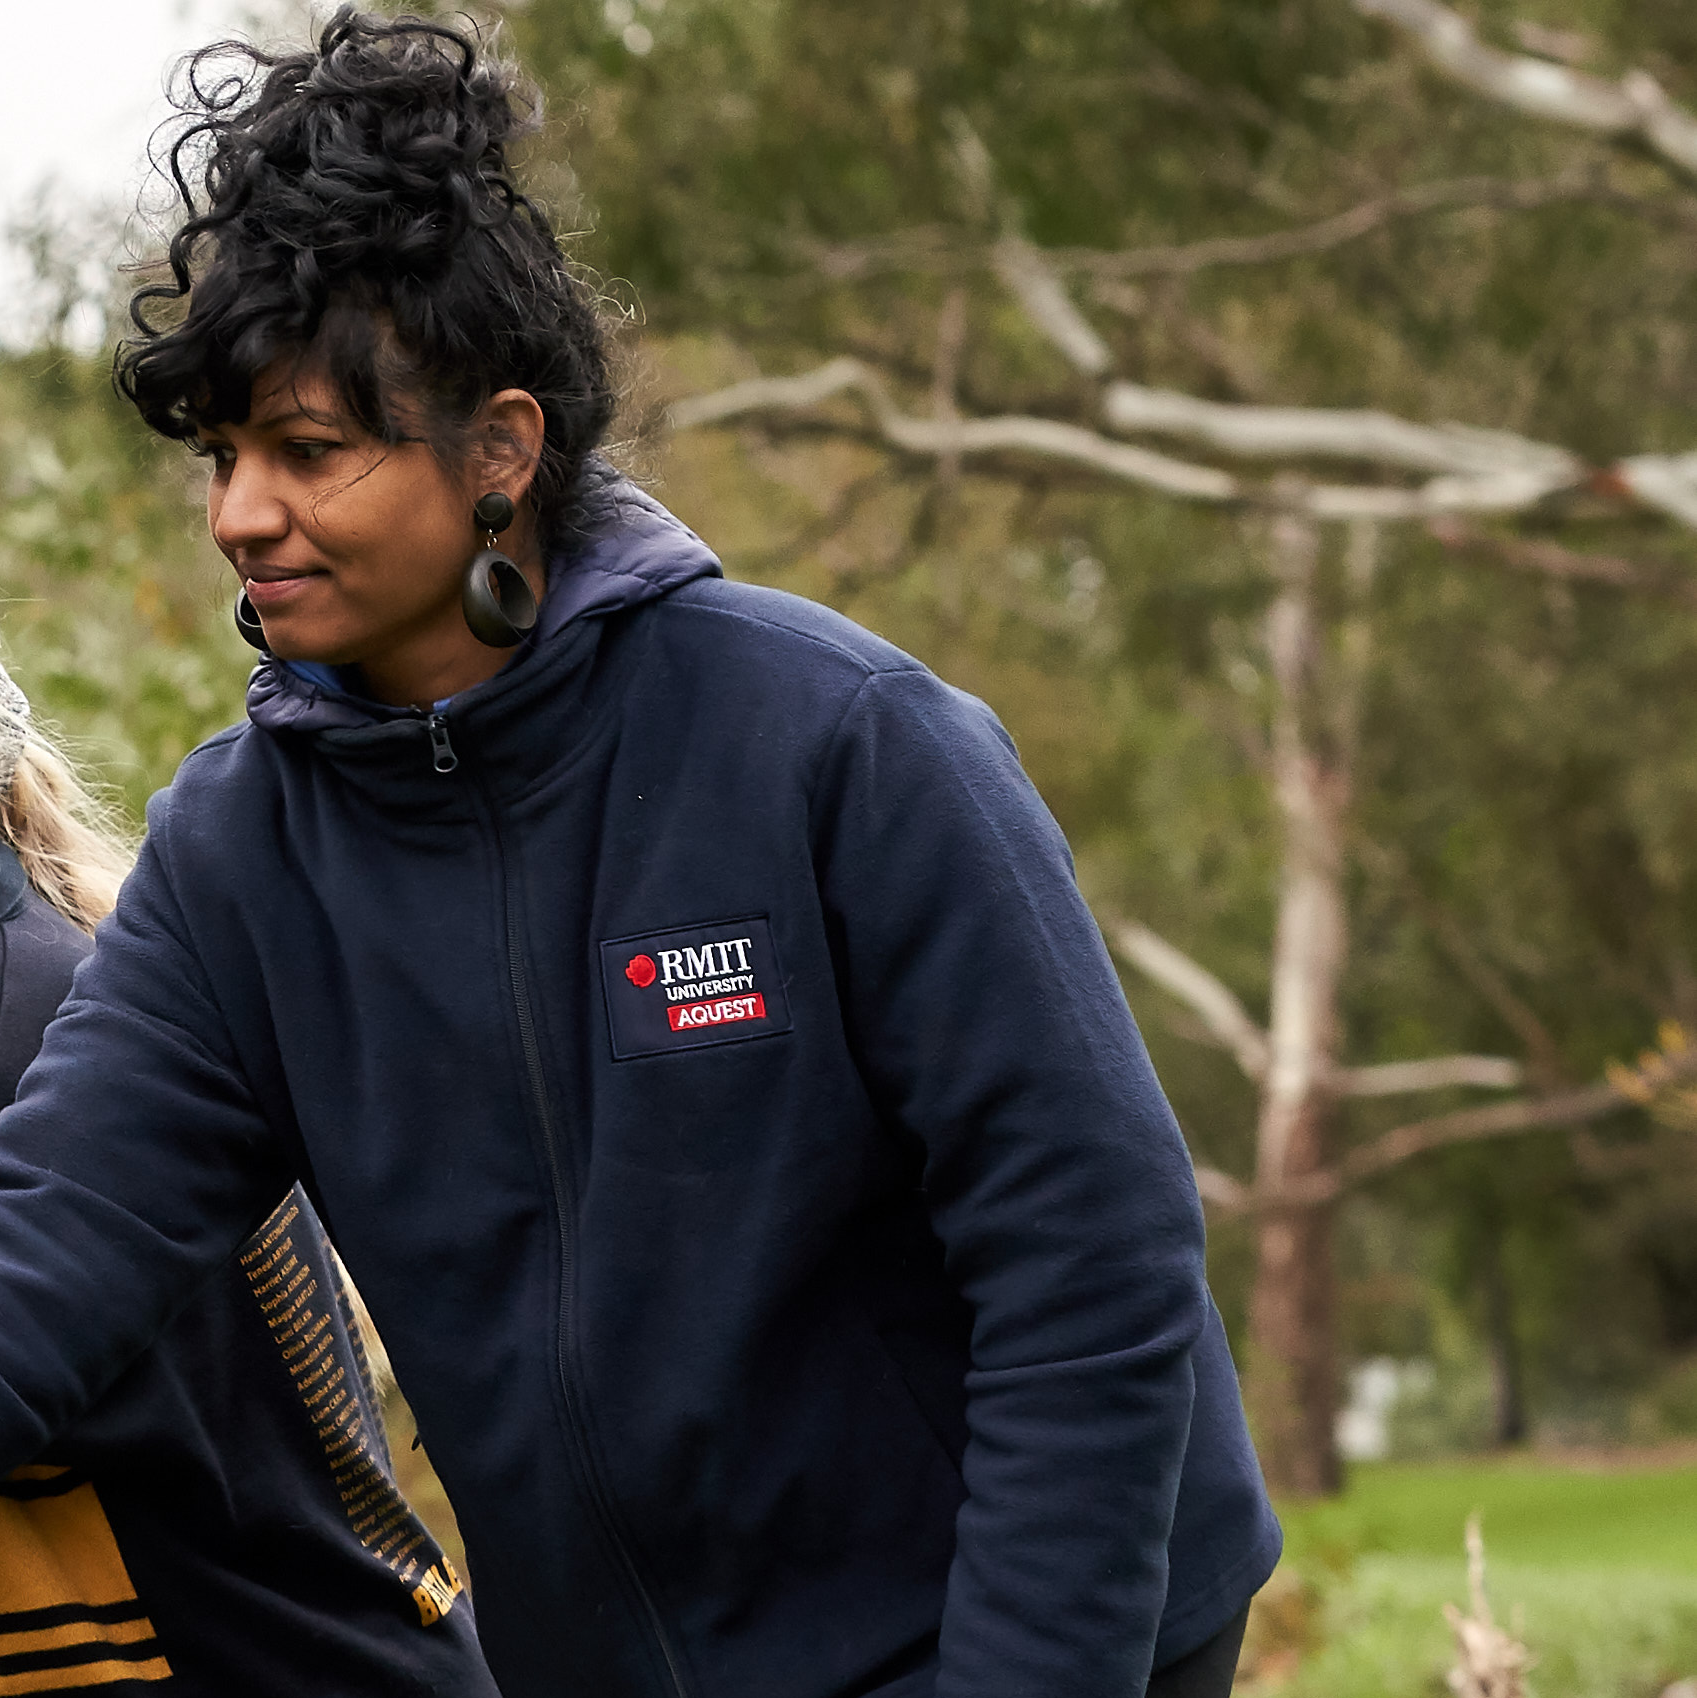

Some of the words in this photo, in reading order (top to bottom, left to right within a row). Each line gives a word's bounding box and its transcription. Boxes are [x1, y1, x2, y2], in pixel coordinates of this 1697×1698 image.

[657, 938, 752, 985] RMIT
[665, 974, 754, 1001] UNIVERSITY
[677, 997, 757, 1027] AQUEST
